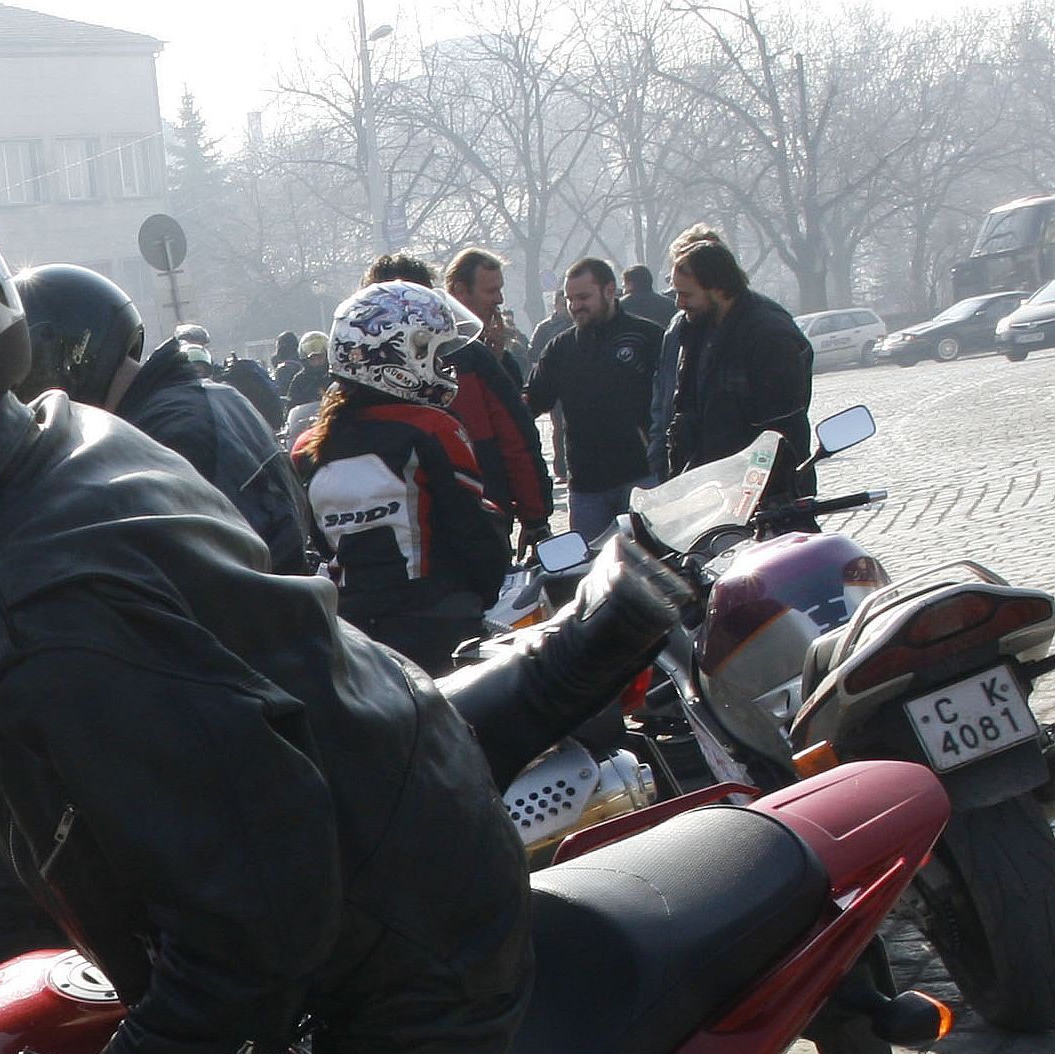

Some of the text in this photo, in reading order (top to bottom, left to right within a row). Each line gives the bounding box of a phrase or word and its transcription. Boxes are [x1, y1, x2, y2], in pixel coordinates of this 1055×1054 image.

[934, 677, 1008, 724] C K
[941, 707, 1020, 756] 4081
